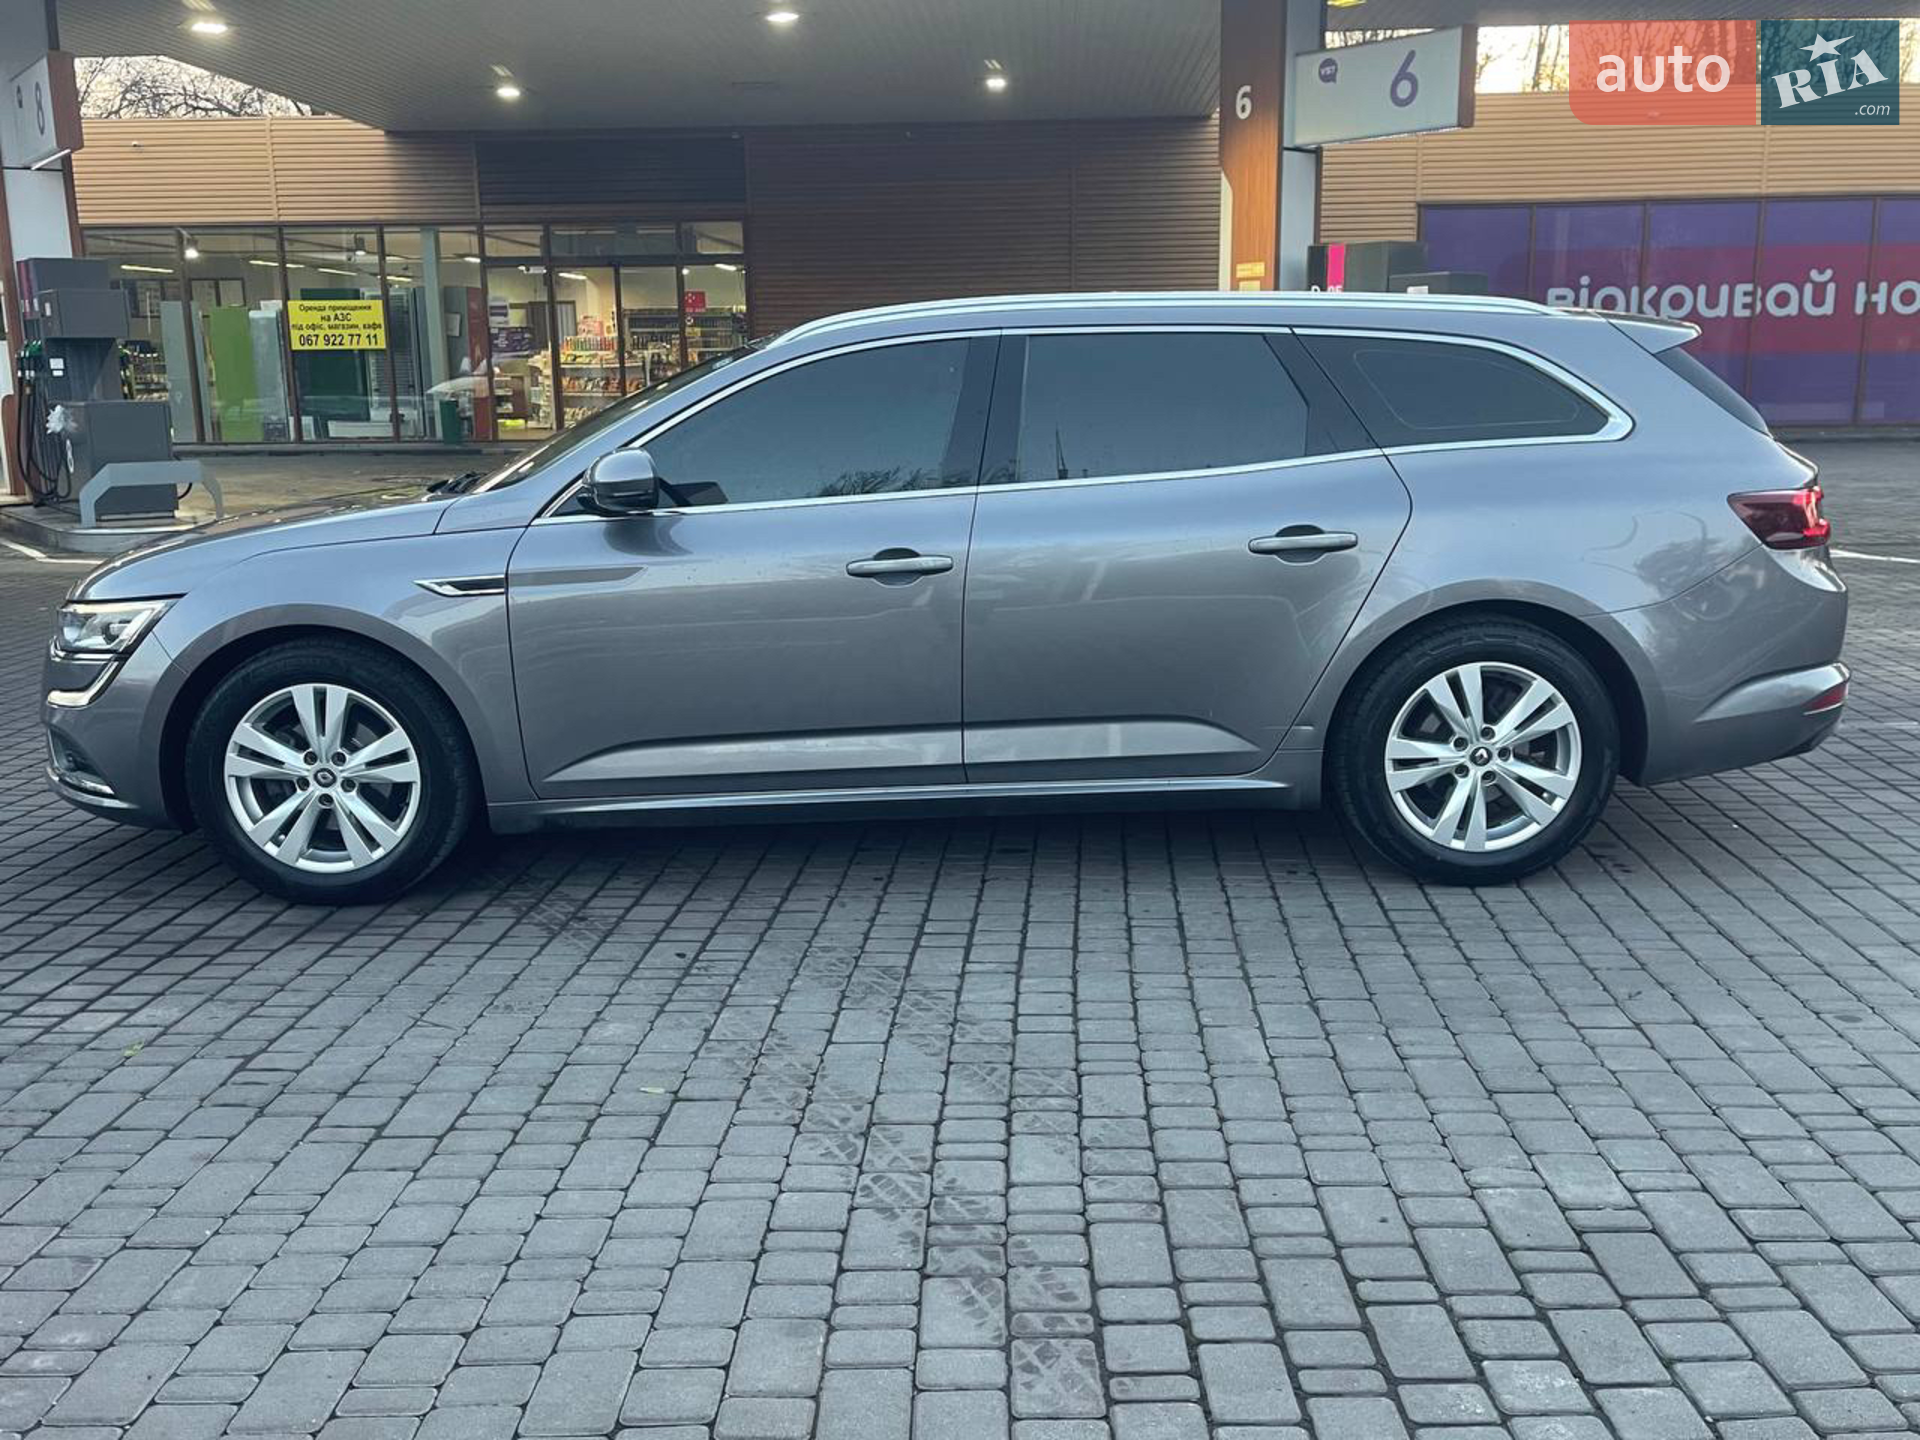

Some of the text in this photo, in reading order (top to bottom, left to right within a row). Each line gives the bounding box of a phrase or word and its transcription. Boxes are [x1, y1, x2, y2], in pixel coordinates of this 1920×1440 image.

[1390, 50, 1419, 108] 6
[35, 81, 46, 136] 8
[1236, 85, 1252, 120] 6
[333, 312, 352, 322] АЗС
[299, 333, 379, 346] 067 922 77 11
